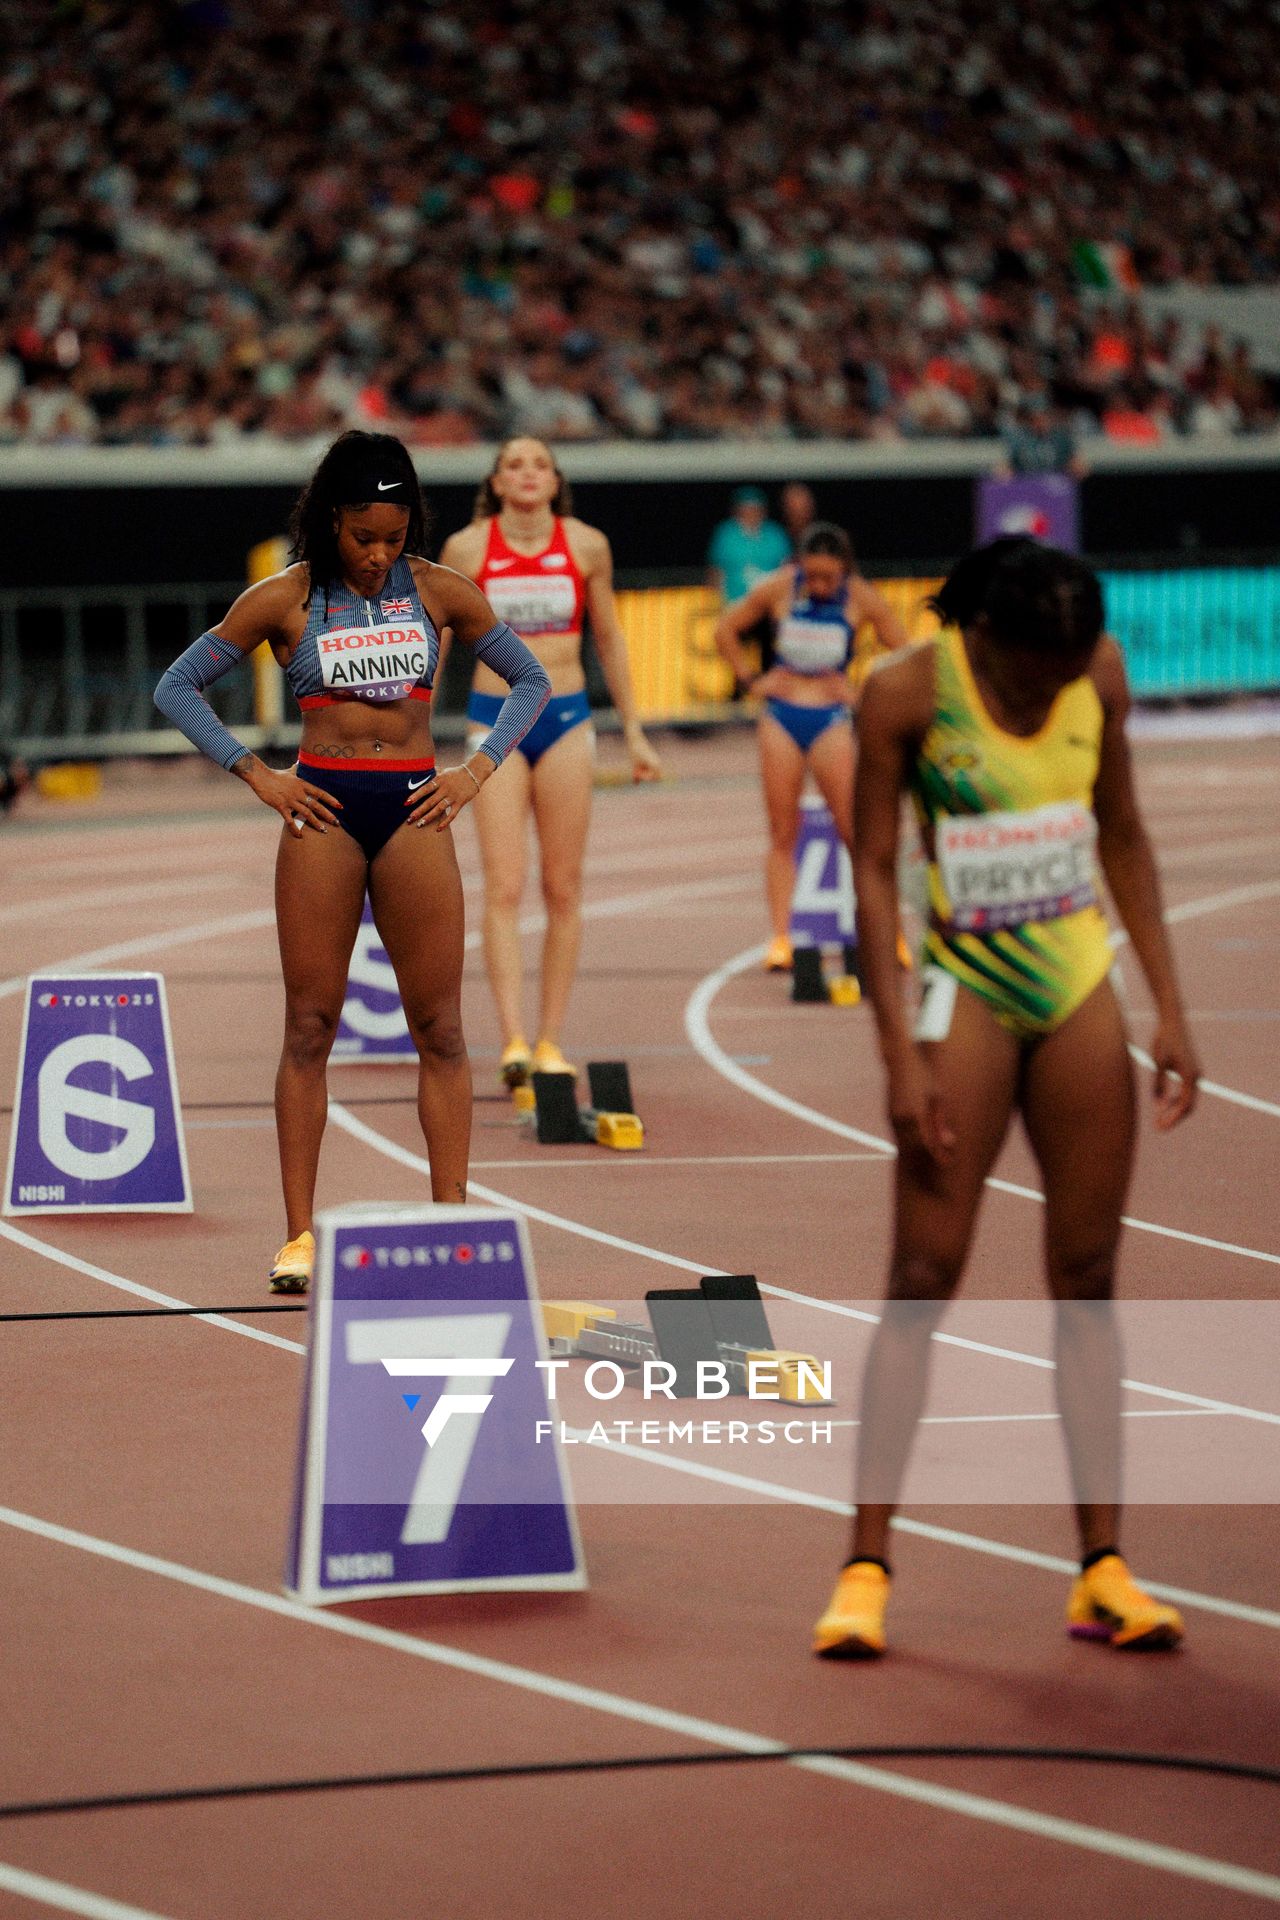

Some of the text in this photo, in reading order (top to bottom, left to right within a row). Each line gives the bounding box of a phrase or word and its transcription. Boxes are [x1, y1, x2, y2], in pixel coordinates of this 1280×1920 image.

[320, 629, 426, 654] HONDA
[330, 652, 425, 685] ANNING
[791, 839, 857, 932] 4
[38, 1033, 156, 1181] 6
[19, 1185, 66, 1202] NISHI
[345, 1311, 514, 1546] 7
